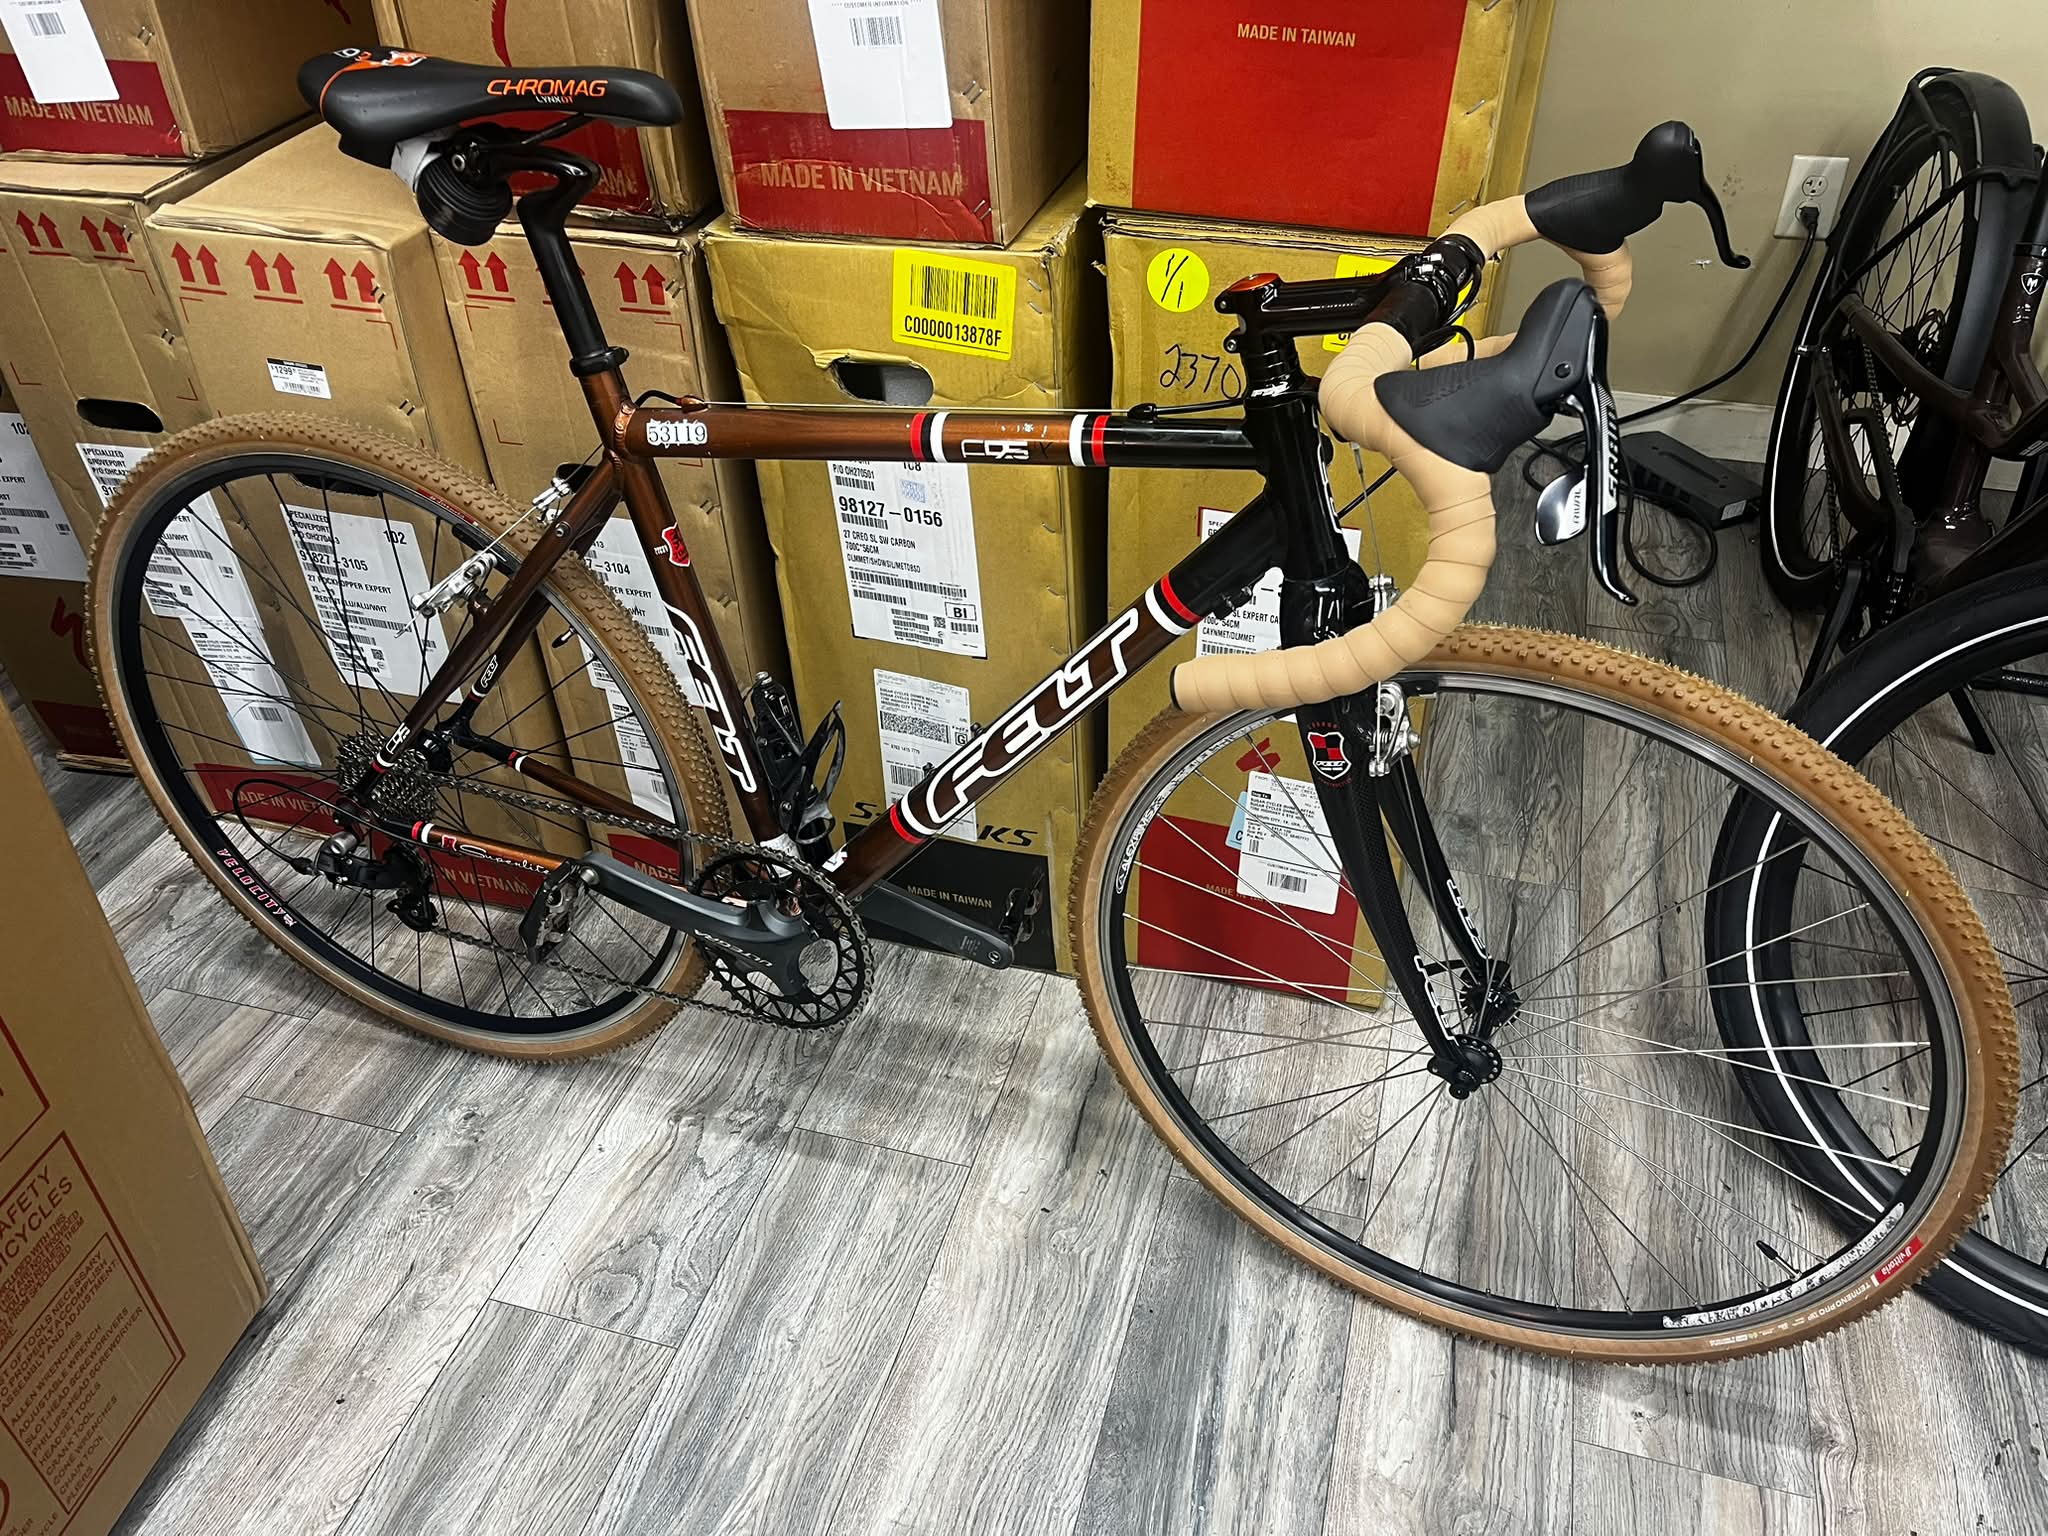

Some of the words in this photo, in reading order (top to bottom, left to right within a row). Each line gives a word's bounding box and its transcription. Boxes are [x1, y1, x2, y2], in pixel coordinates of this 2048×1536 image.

[1237, 23, 1278, 40] MADE
[1282, 27, 1297, 42] IN
[1301, 28, 1356, 47] TAIWAN
[487, 79, 608, 97] CHROMAG
[56, 102, 76, 120] IN
[77, 102, 154, 126] VIETNAM
[760, 162, 825, 189] MADE
[831, 164, 854, 190] IN
[859, 167, 962, 195] VIETNAM
[904, 315, 1002, 346] C0000013878F
[1160, 343, 1242, 399] 2370
[648, 426, 706, 442] 53119
[288, 510, 330, 523] PECIALIZED
[383, 530, 407, 544] 102
[852, 531, 868, 541] CREO
[890, 537, 916, 549] CARBON
[626, 588, 652, 598] EXPERT
[953, 607, 967, 618] BI
[1242, 611, 1270, 623] EXPERT
[216, 848, 287, 915] VELOCITY
[907, 885, 937, 899] MADE
[939, 891, 950, 901] IN
[952, 893, 992, 909] TAIWAN
[0, 1165, 51, 1241] AFETY
[0, 1176, 73, 1268] ICYCLES
[51, 1250, 102, 1316] NECESSARY
[69, 1305, 130, 1386] SCREWDRIVERS
[88, 1305, 144, 1380] SCREWDRIVER
[11, 1391, 38, 1426] ALLEN
[35, 1330, 83, 1391] WRENCHES
[18, 1370, 69, 1438] ADJUSTABLE
[66, 1324, 102, 1371] WRENCH
